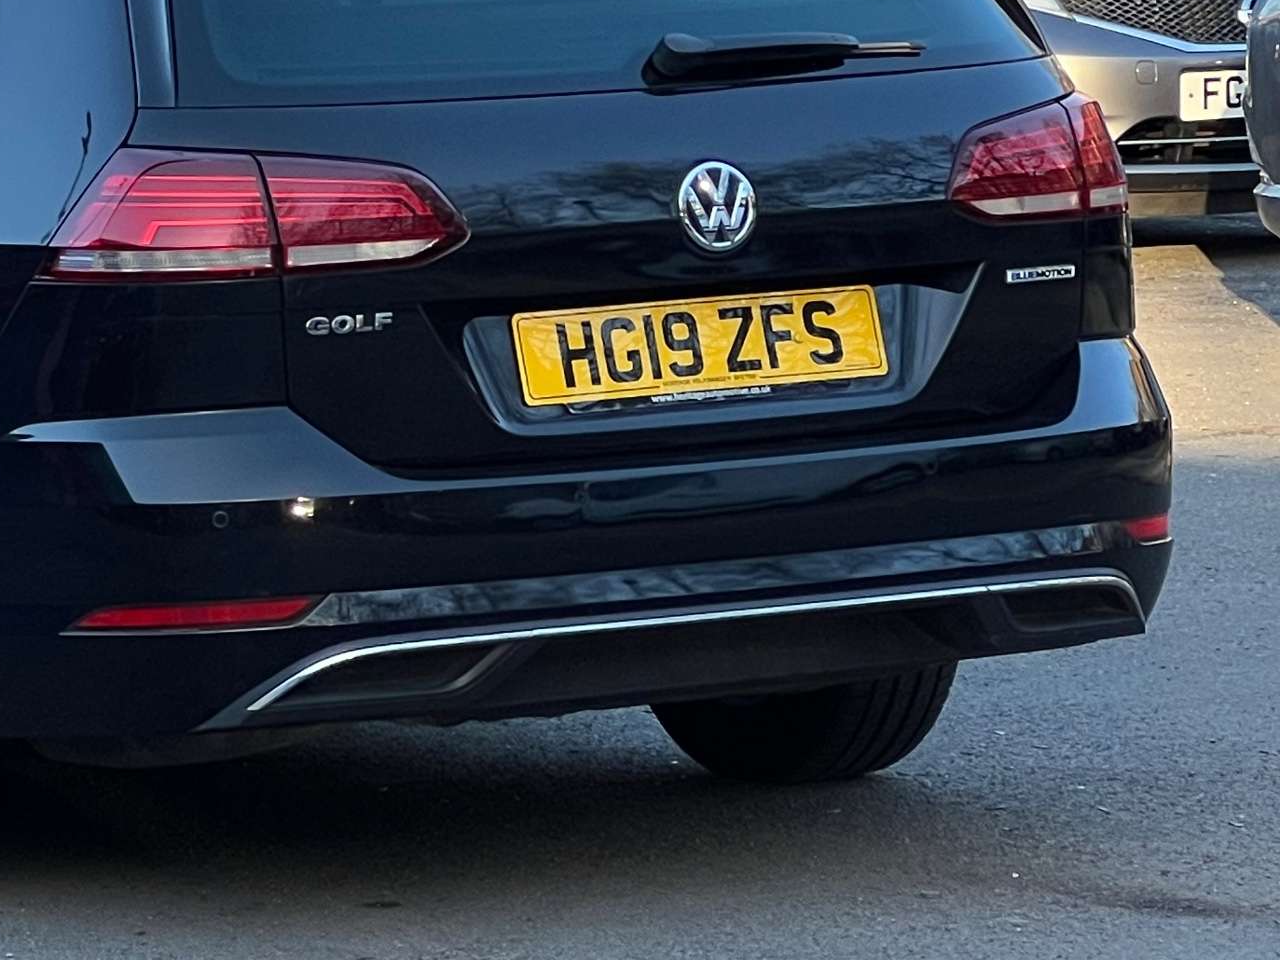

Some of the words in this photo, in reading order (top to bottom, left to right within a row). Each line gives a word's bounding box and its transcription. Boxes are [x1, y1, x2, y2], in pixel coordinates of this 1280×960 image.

[1203, 75, 1244, 110] FG
[305, 311, 393, 336] GOLF
[555, 311, 704, 388] HG19
[718, 299, 845, 373] ZFS
